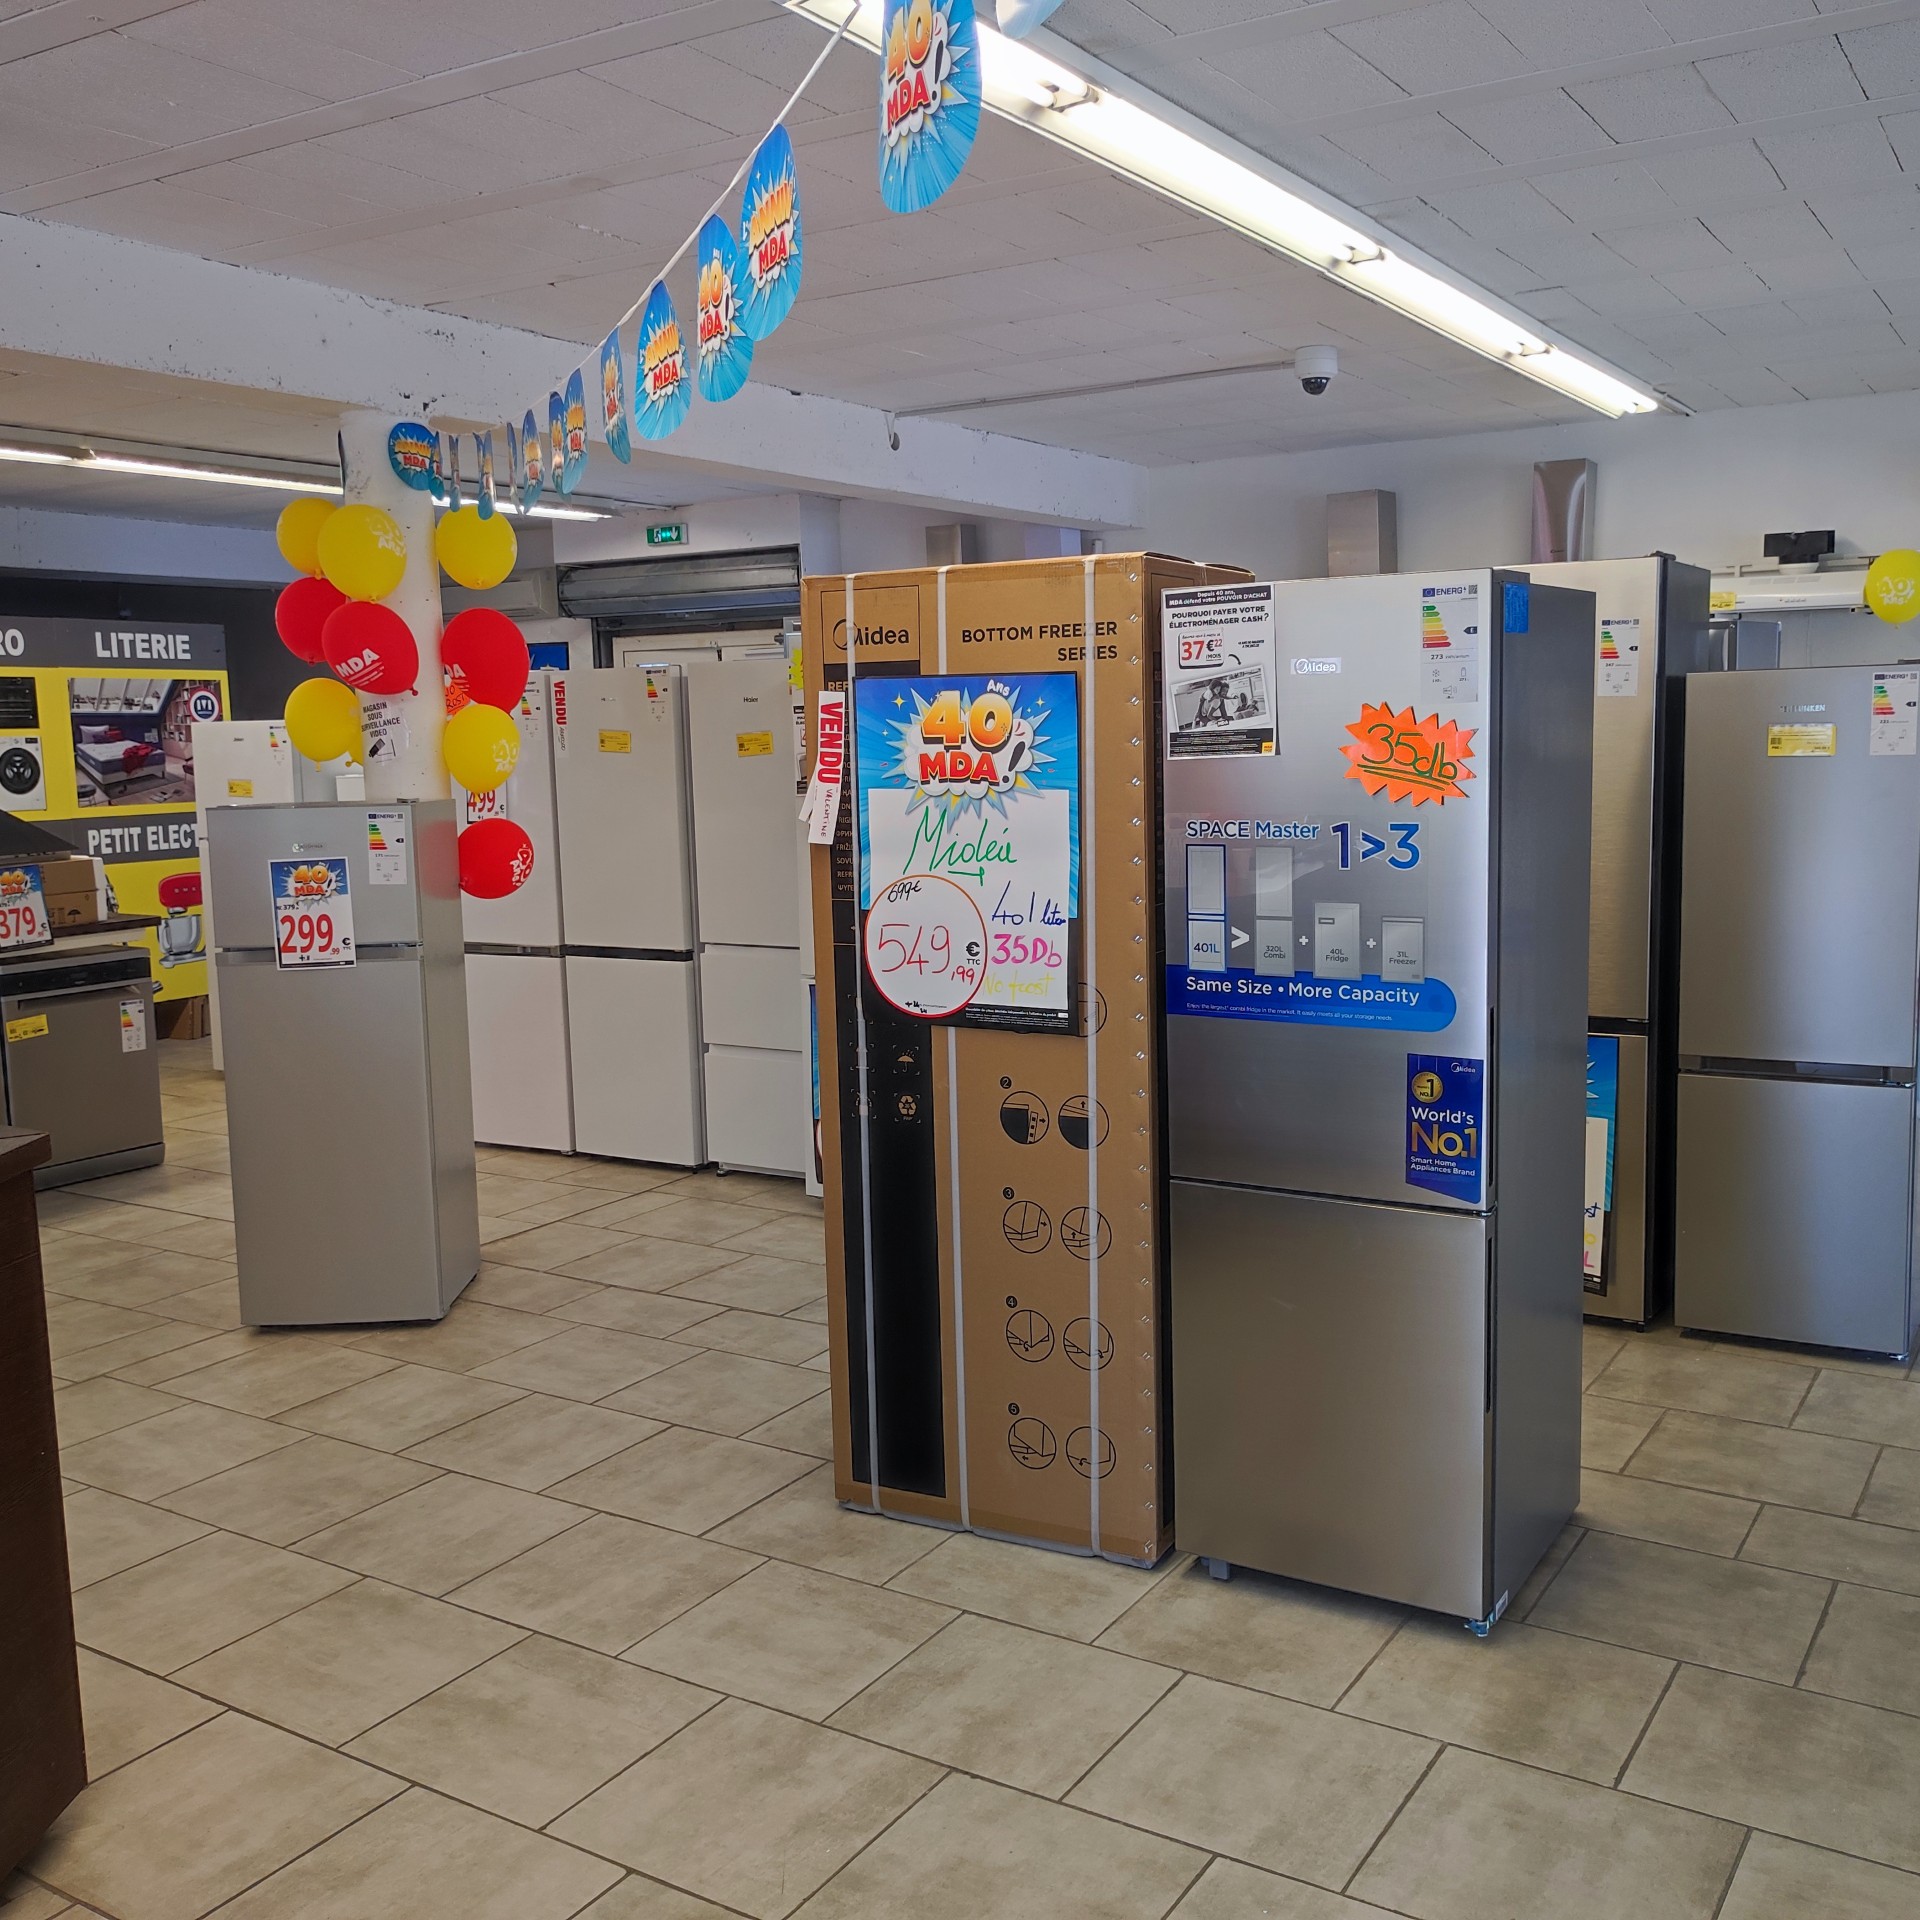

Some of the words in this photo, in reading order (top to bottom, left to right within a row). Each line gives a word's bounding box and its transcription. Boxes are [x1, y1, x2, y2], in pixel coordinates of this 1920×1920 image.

[887, 0, 933, 82] 40
[758, 230, 788, 281] MDA
[652, 358, 680, 395] MDA
[403, 453, 427, 468] MDA
[1216, 594, 1242, 602] POUVOIR
[1172, 609, 1211, 619] POURQUOI
[1212, 607, 1238, 616] PAYER
[1239, 605, 1266, 614] VOTRE
[1169, 616, 1240, 629] ÉLECTROMÉNAGER
[1241, 615, 1263, 623] CASH
[832, 618, 910, 651] Midea
[961, 625, 1033, 643] BOTTOM
[95, 631, 192, 660] LITERIE
[1181, 640, 1205, 661] 37
[335, 647, 381, 678] MDA
[1296, 658, 1336, 674] Midea
[986, 678, 1011, 697] Ans
[362, 701, 388, 714] MAGASIN
[553, 680, 567, 726] VENDU
[361, 716, 401, 732] SURVEILLANCE
[367, 711, 383, 722] SOUS
[920, 689, 1014, 754] 40
[369, 728, 388, 738] VIDEO
[817, 701, 844, 785] VENDU
[1185, 821, 1251, 839] SPACE
[1254, 821, 1321, 840] Master
[87, 826, 142, 856] PETIT
[293, 863, 329, 885] 40
[280, 913, 334, 954] 299
[1193, 942, 1221, 954] 401L
[1263, 951, 1286, 960] Combi
[1265, 945, 1284, 953] 320L
[1329, 948, 1345, 956] 40L
[966, 957, 981, 966] TTC
[1325, 955, 1349, 963] Fridge
[1388, 957, 1417, 966] Freezer
[1186, 976, 1233, 992] Same
[1237, 979, 1273, 995] Size
[1288, 983, 1333, 999] More
[1338, 985, 1420, 1006] Capacity
[1186, 1002, 1200, 1010] Enjoy
[1246, 1006, 1262, 1014] fridge
[1354, 1013, 1375, 1021] storage
[1450, 1062, 1476, 1073] Midea
[1426, 1078, 1434, 1098] 1
[1411, 1106, 1474, 1125] World's
[1411, 1121, 1477, 1159] No.1
[1410, 1156, 1433, 1165] Smart
[1434, 1158, 1457, 1167] Home
[1410, 1163, 1452, 1174] Appliances
[1452, 1167, 1476, 1177] Brand
